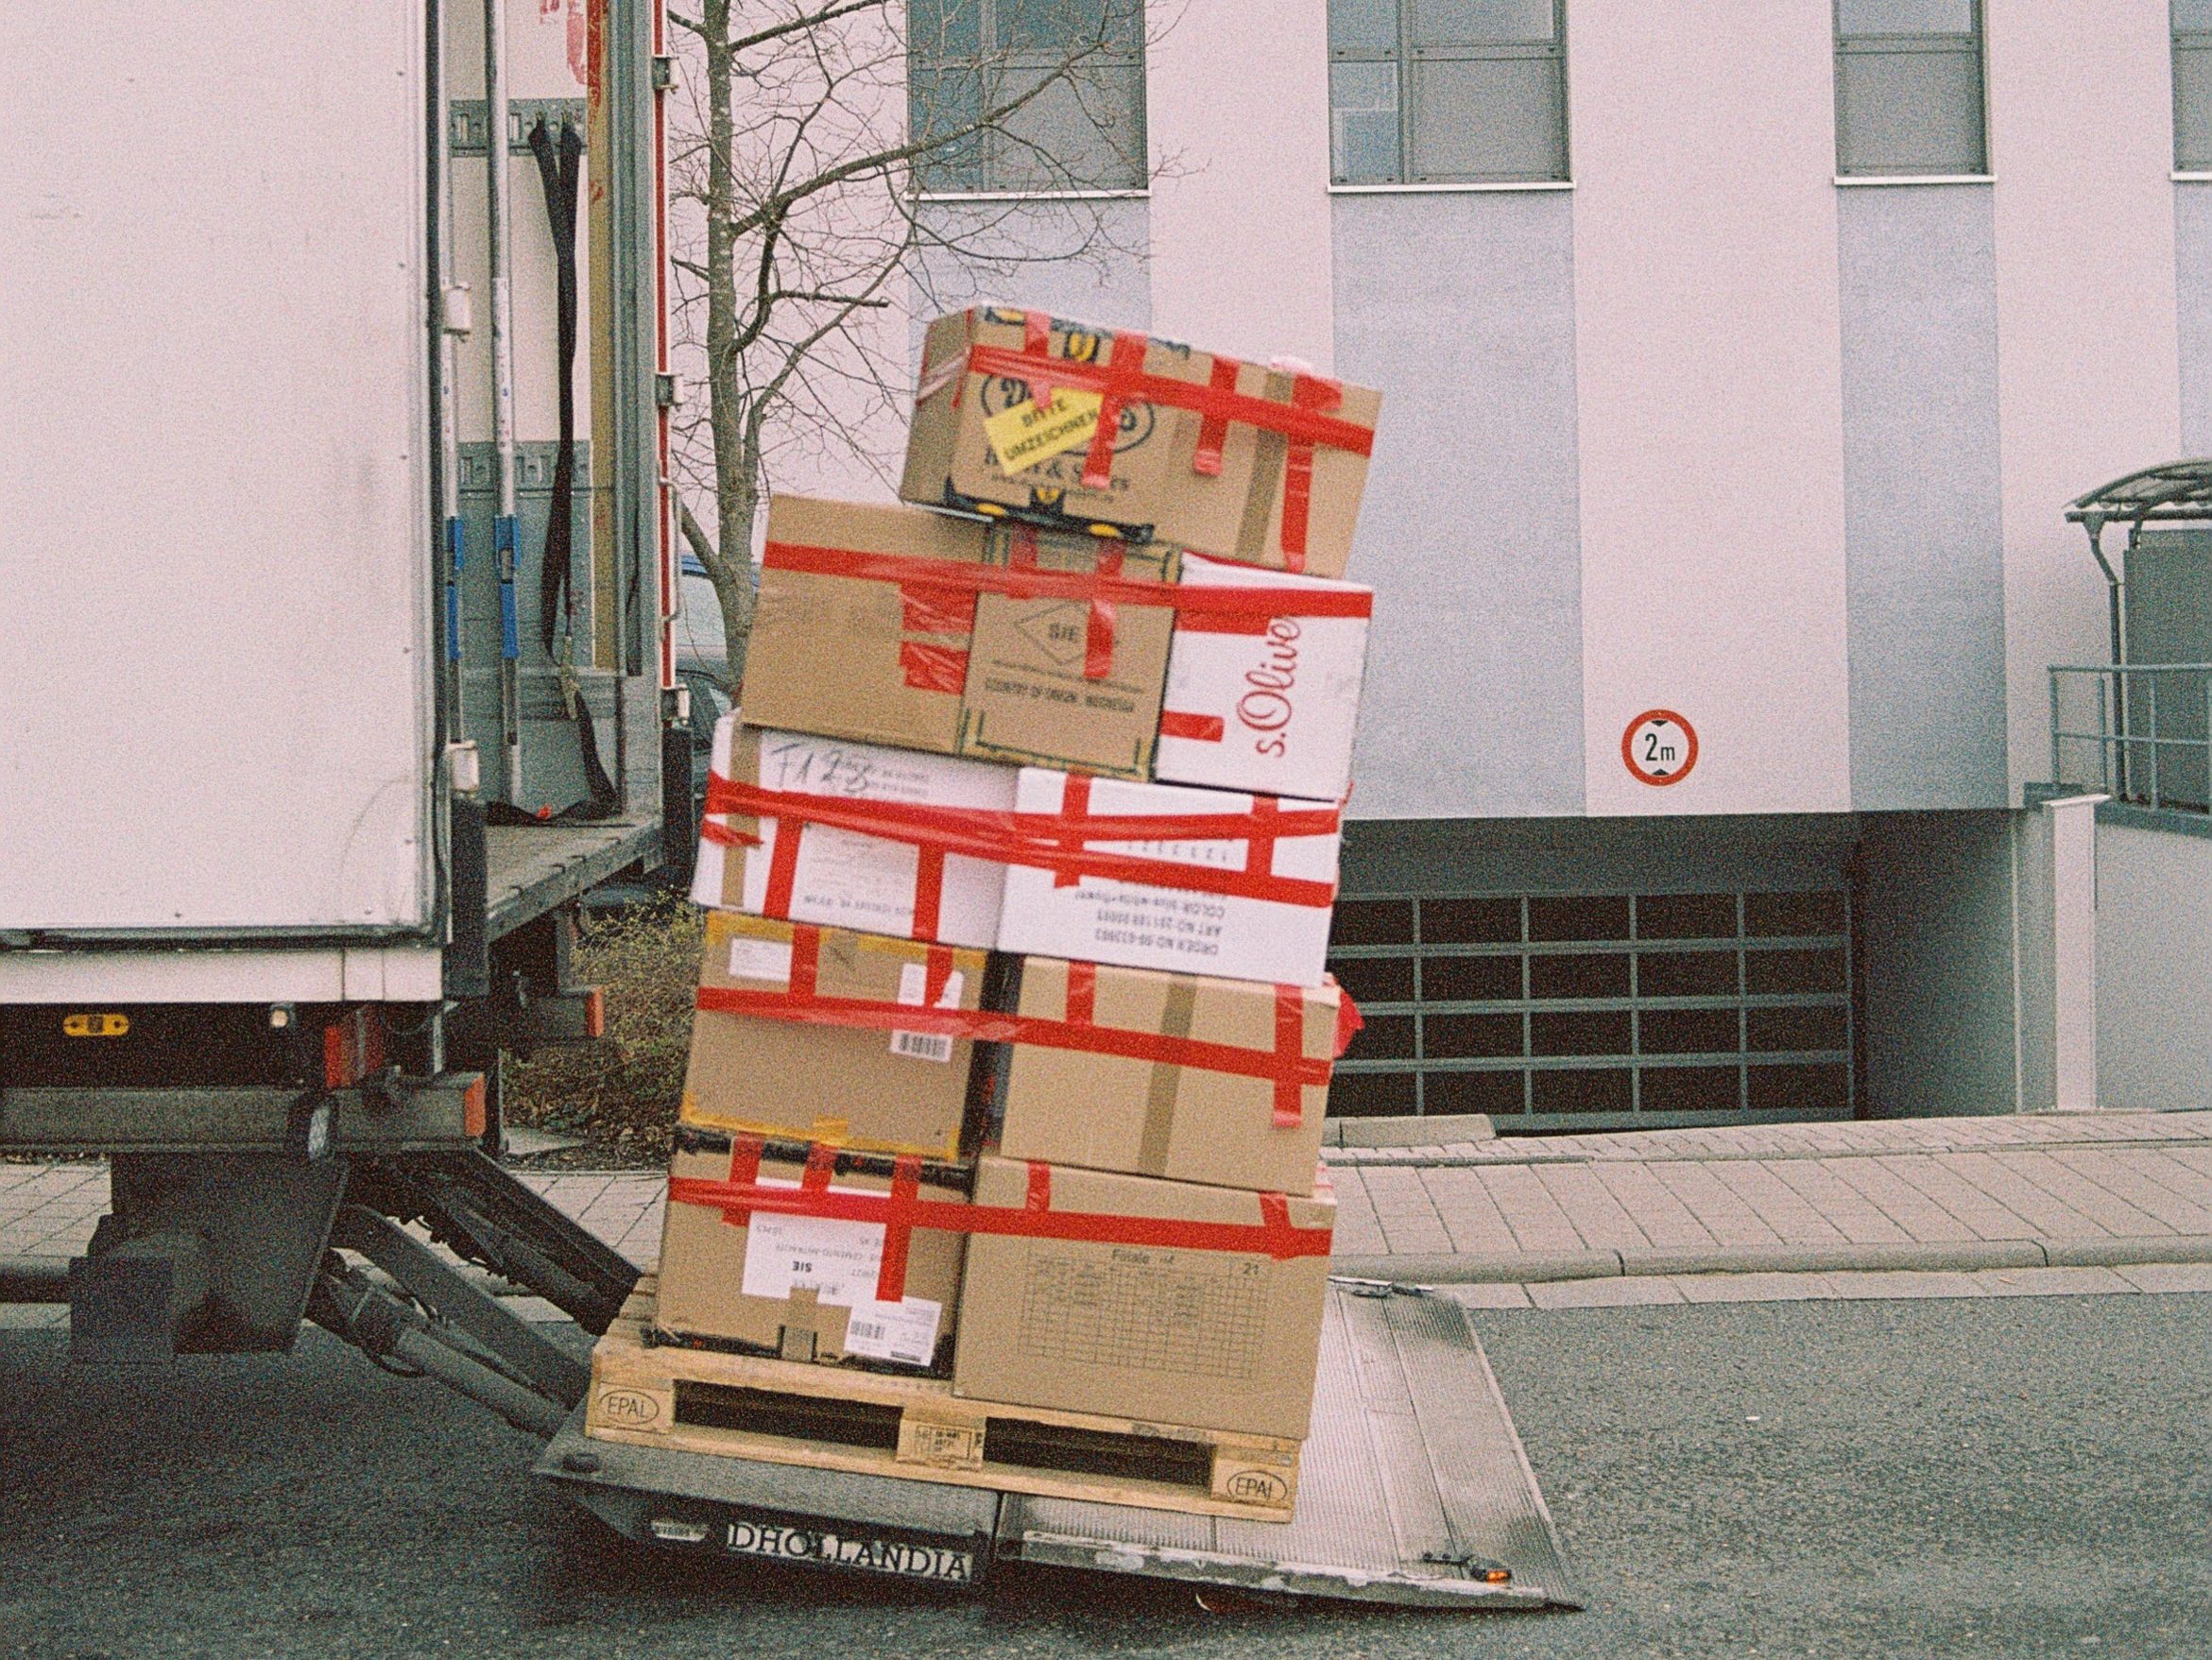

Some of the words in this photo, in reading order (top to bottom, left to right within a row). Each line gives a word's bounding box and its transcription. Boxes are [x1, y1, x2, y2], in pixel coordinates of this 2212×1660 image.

[1237, 615, 1301, 758] s.Olive
[792, 1260, 814, 1273] SIE
[608, 1396, 649, 1419] EPAL
[728, 1521, 968, 1580] DHOLLANDIA
